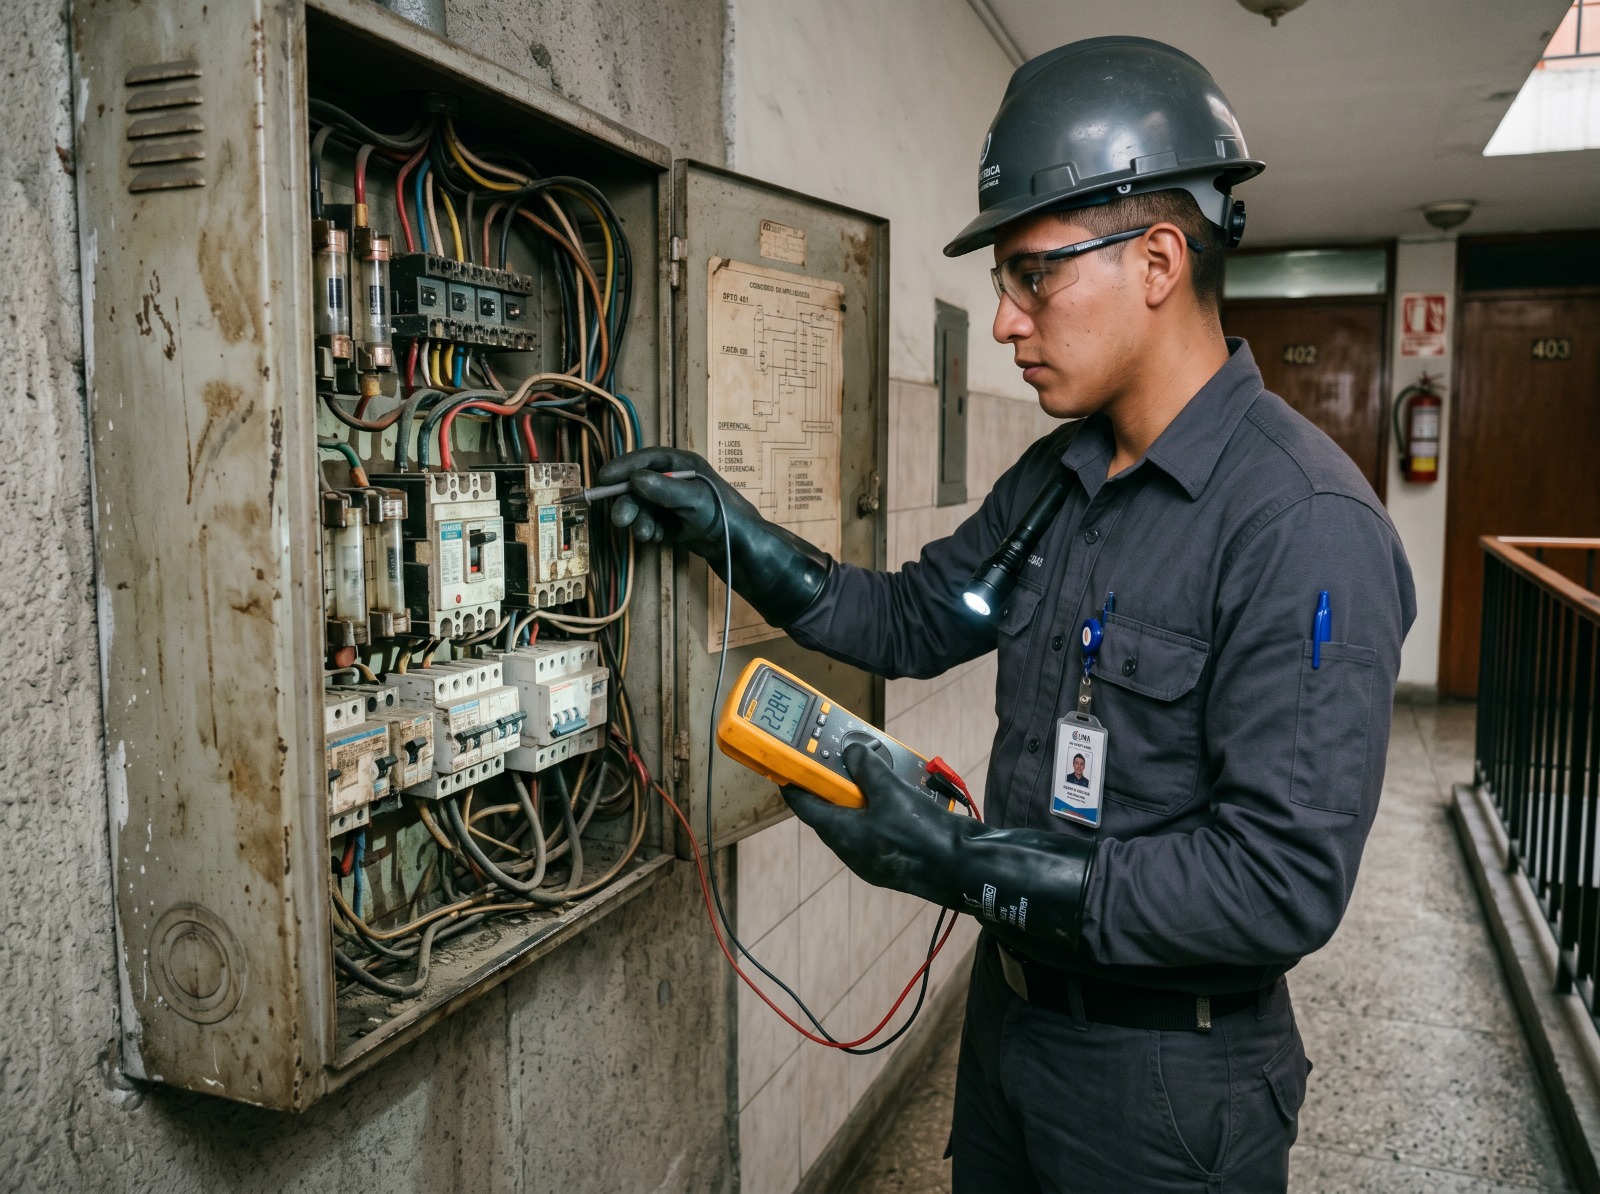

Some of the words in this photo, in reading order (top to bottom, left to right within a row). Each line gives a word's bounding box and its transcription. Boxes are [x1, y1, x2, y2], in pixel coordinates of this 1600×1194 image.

[1284, 346, 1316, 364] 402
[1533, 340, 1570, 359] 403
[718, 421, 751, 430] DIFERENCIAL
[761, 690, 792, 731] 228.4
